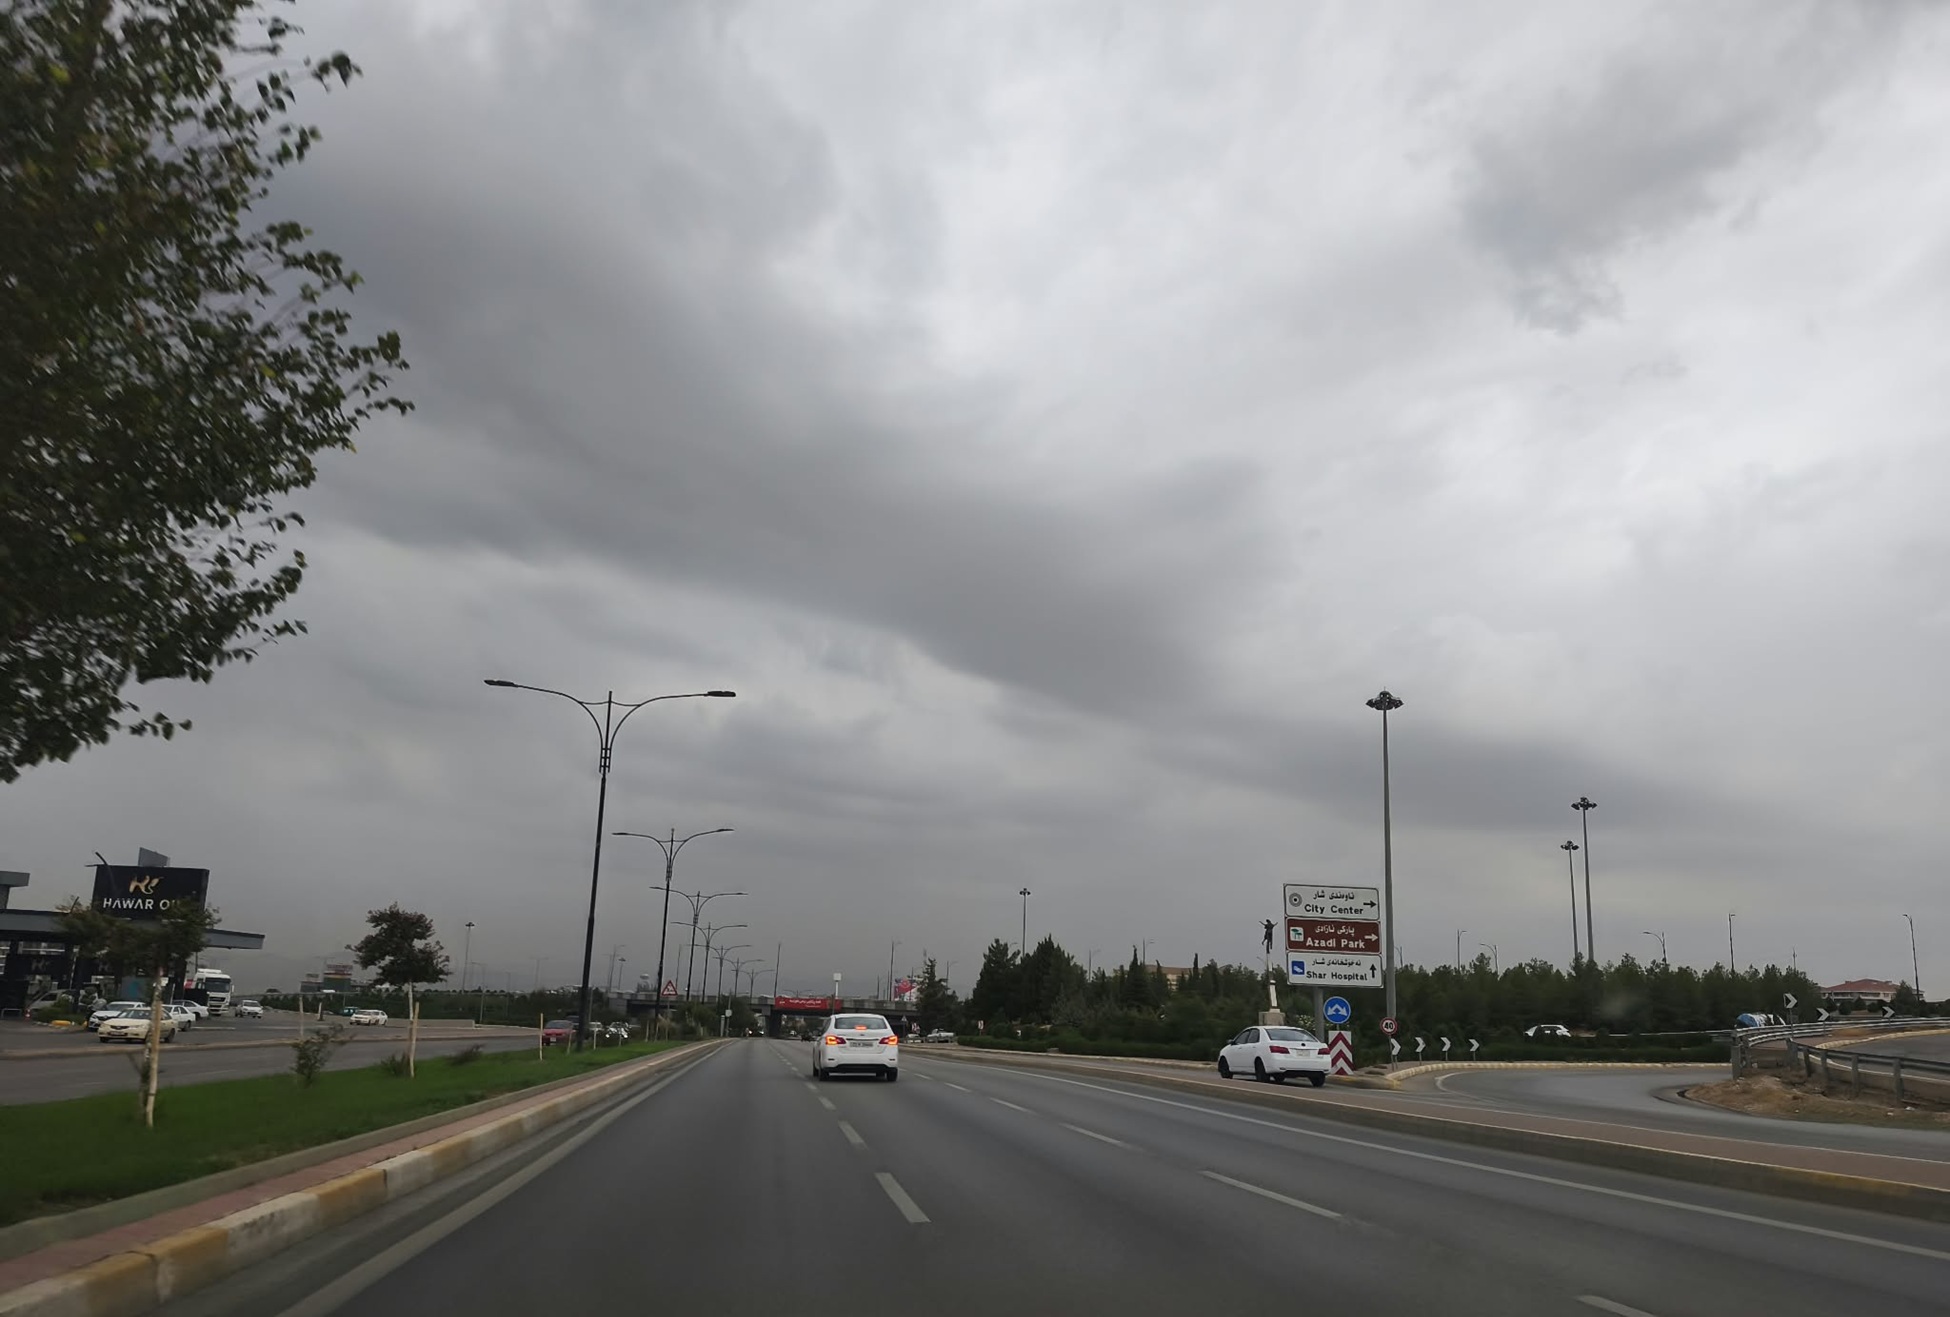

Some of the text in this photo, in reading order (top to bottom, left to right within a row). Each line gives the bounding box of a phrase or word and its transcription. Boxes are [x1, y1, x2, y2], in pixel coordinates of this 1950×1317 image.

[1313, 890, 1325, 900] شار
[103, 898, 154, 910] HAWAR
[1304, 904, 1364, 915] City Center
[1306, 938, 1365, 949] Azadi Park
[1312, 957, 1325, 966] شار
[1306, 971, 1368, 981] Shar Hospital
[1384, 1021, 1394, 1030] 40
